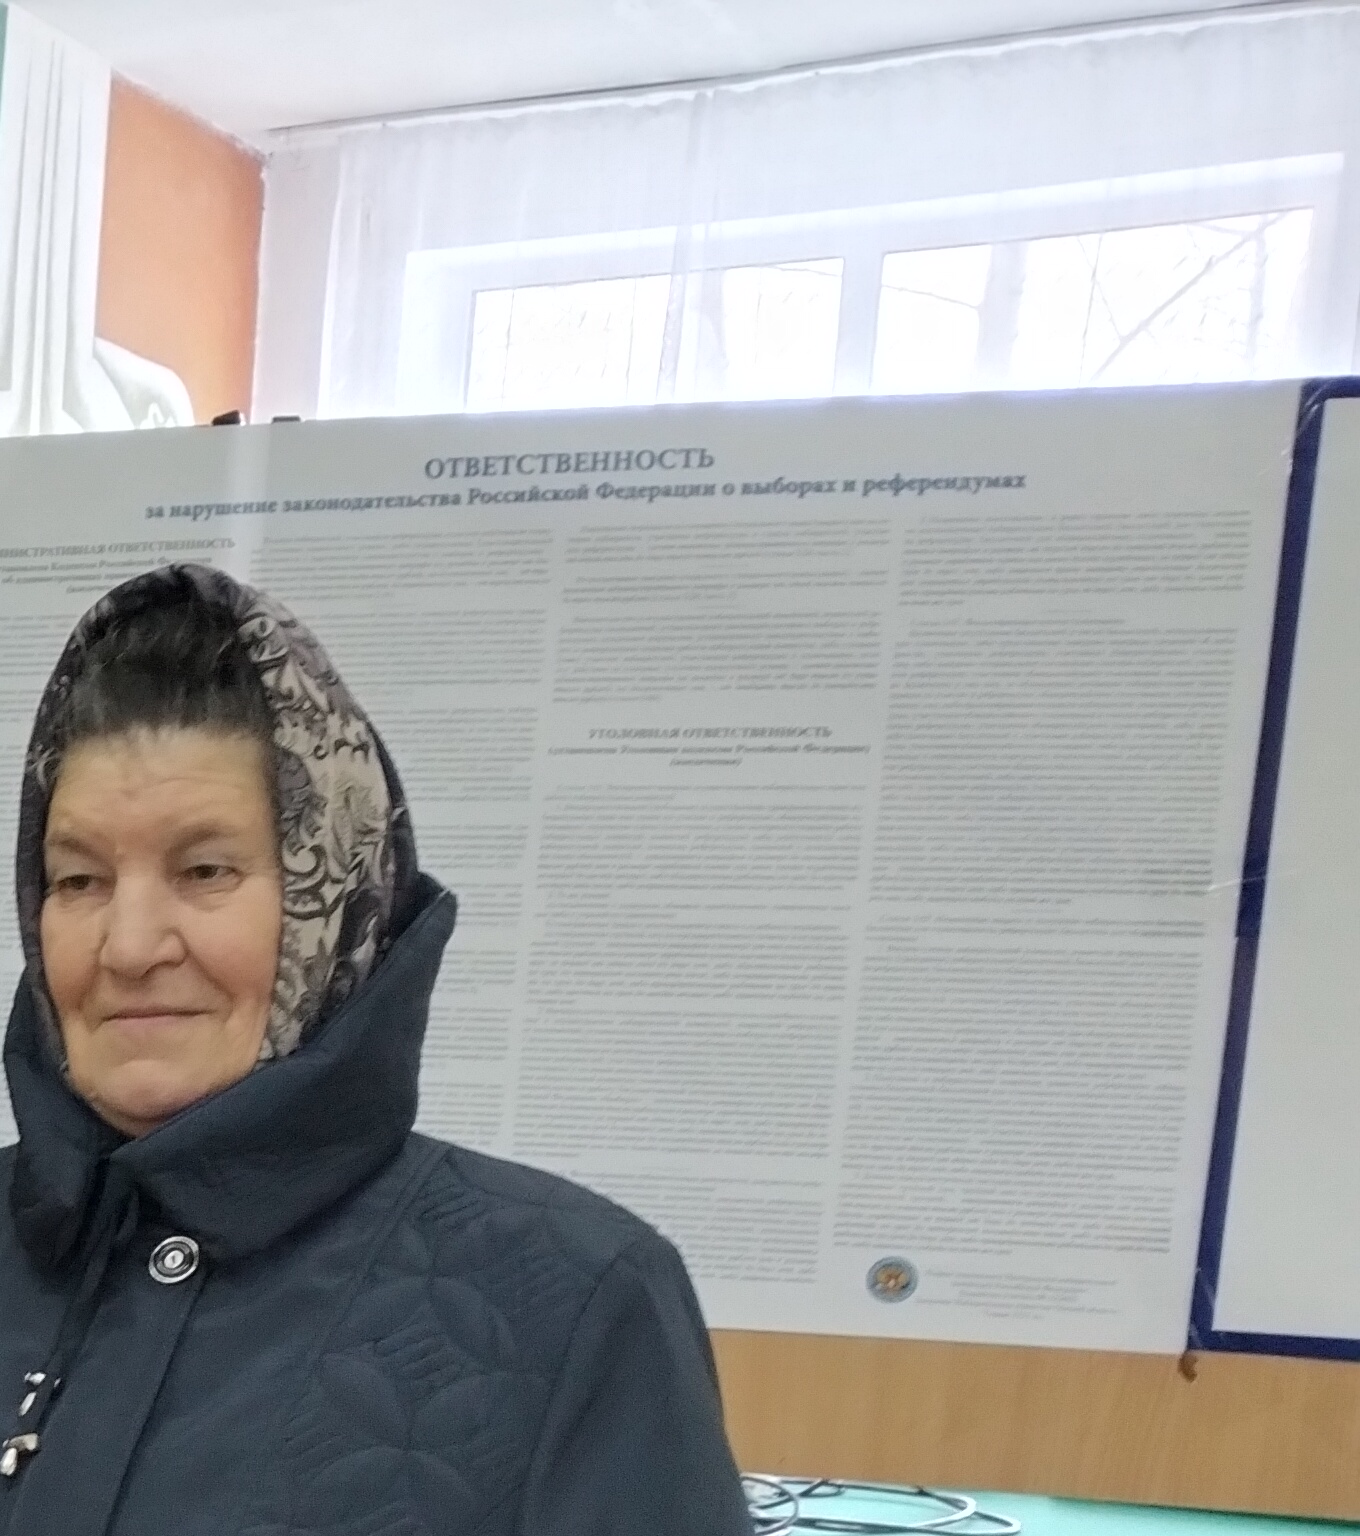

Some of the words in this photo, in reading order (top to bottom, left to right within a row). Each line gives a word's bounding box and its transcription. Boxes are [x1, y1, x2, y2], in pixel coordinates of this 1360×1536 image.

[424, 448, 715, 480] ОТВЕТСТВЕННОСТЬ
[146, 506, 165, 519] за
[169, 501, 278, 522] нарушение
[283, 493, 462, 513] законодательства
[466, 484, 589, 505] Российской
[595, 482, 716, 502] Федерации
[721, 483, 735, 496] о
[741, 476, 837, 498] выборах
[842, 480, 857, 492] и
[861, 474, 1026, 496] референдумах
